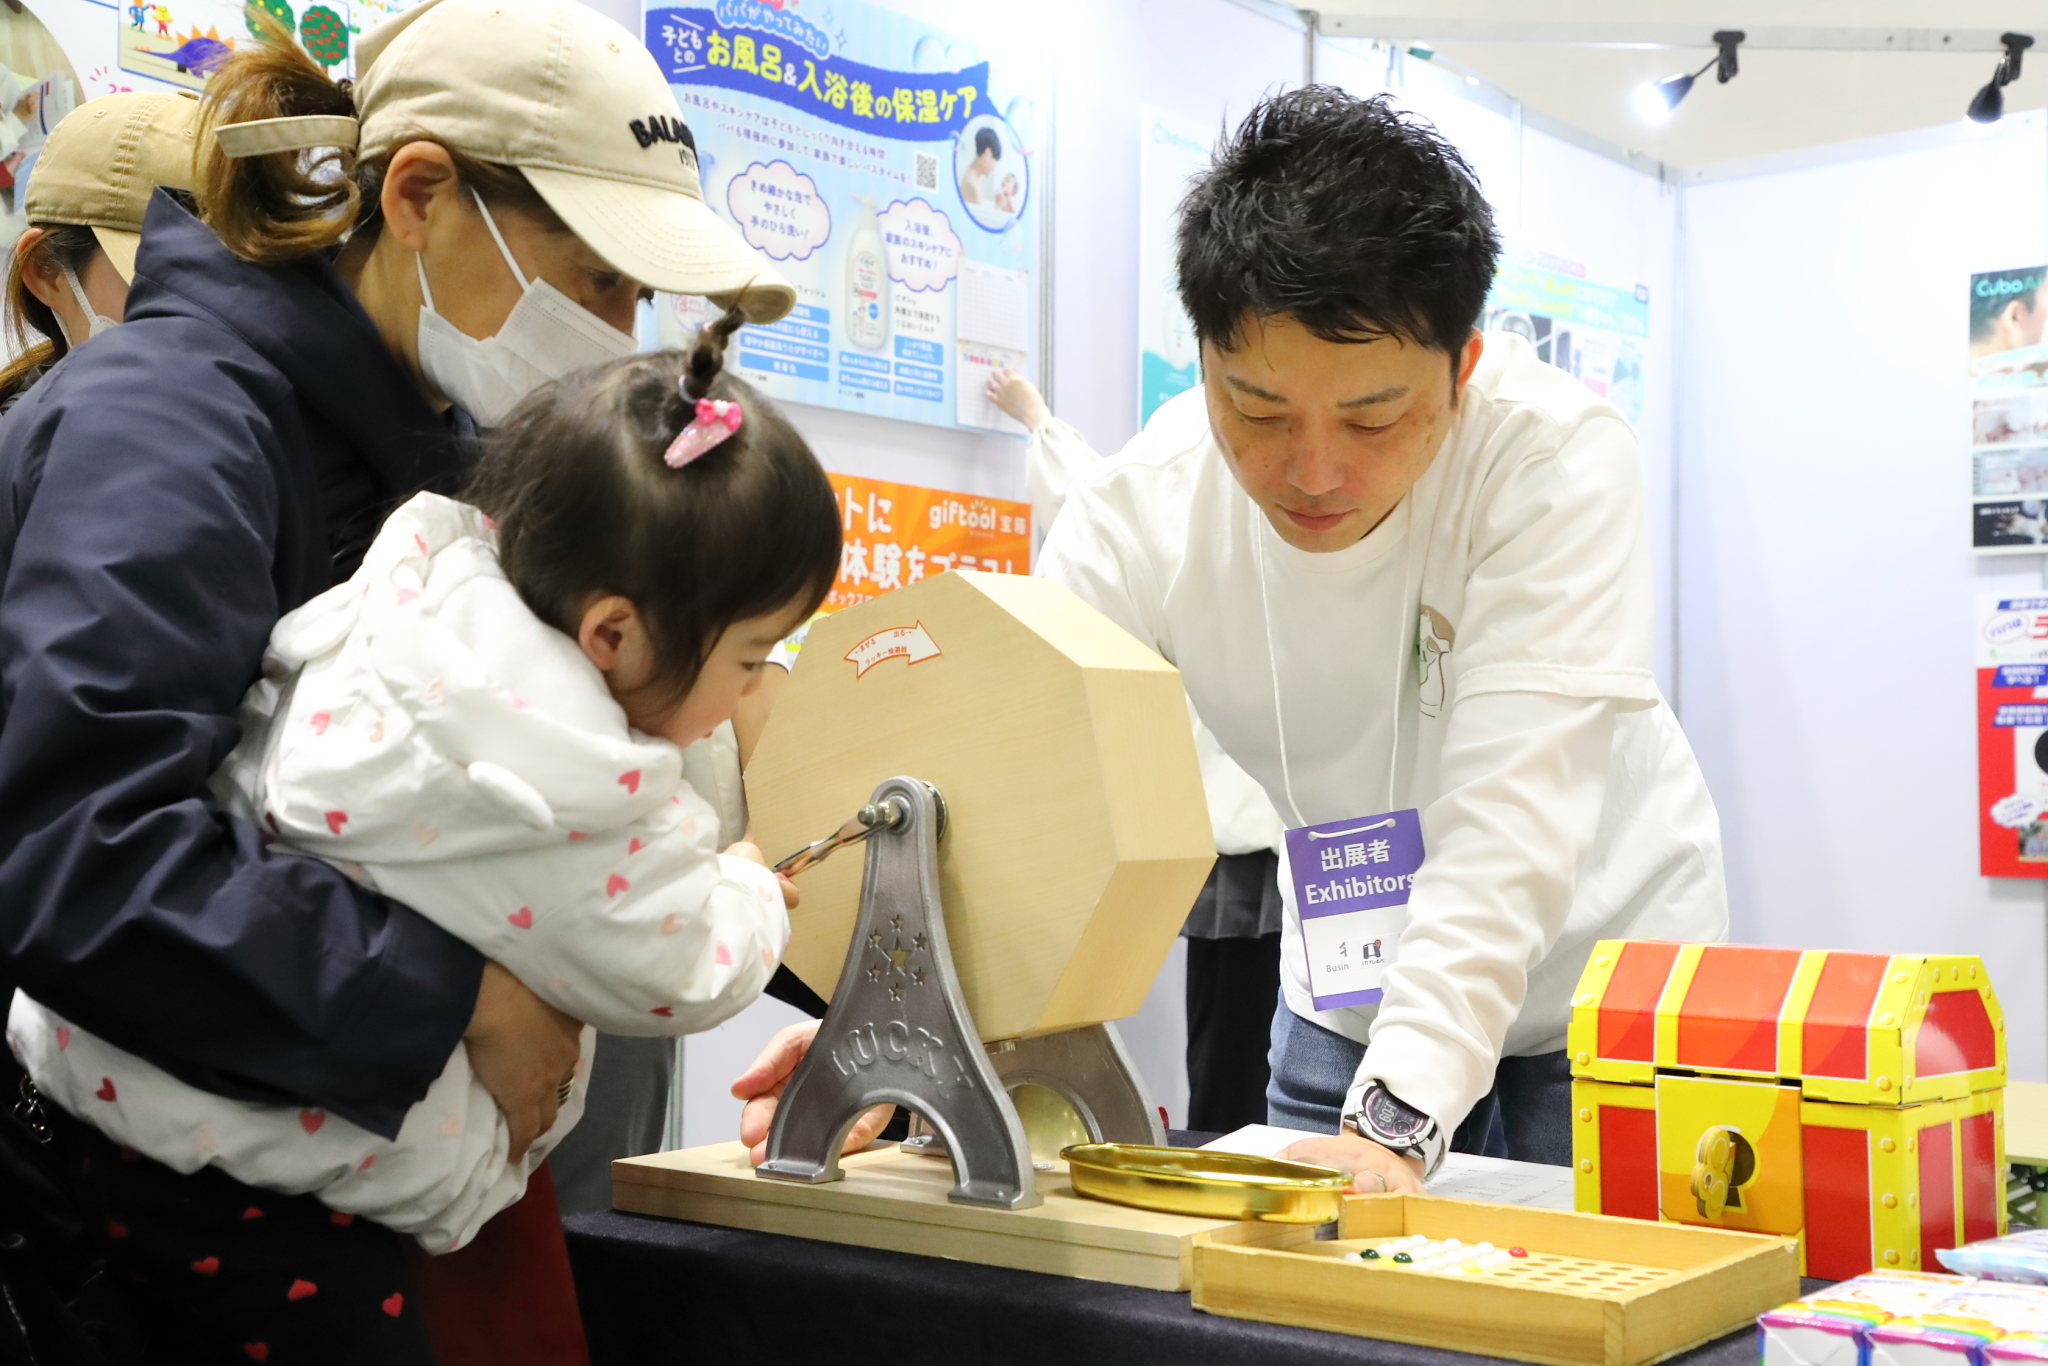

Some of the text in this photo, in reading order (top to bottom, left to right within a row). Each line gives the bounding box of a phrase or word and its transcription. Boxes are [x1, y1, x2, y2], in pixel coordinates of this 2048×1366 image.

[661, 25, 703, 50] 子ども
[673, 47, 696, 64] との
[750, 180, 812, 206] きめ細かな泡で
[763, 202, 797, 219] やさしく
[885, 232, 953, 258] 家族のスキンケアに
[835, 486, 892, 533] トに
[929, 500, 996, 530] giftool
[1320, 839, 1391, 872] 出展者
[1304, 872, 1414, 905] Exhibitors
[1326, 962, 1350, 973] Busin
